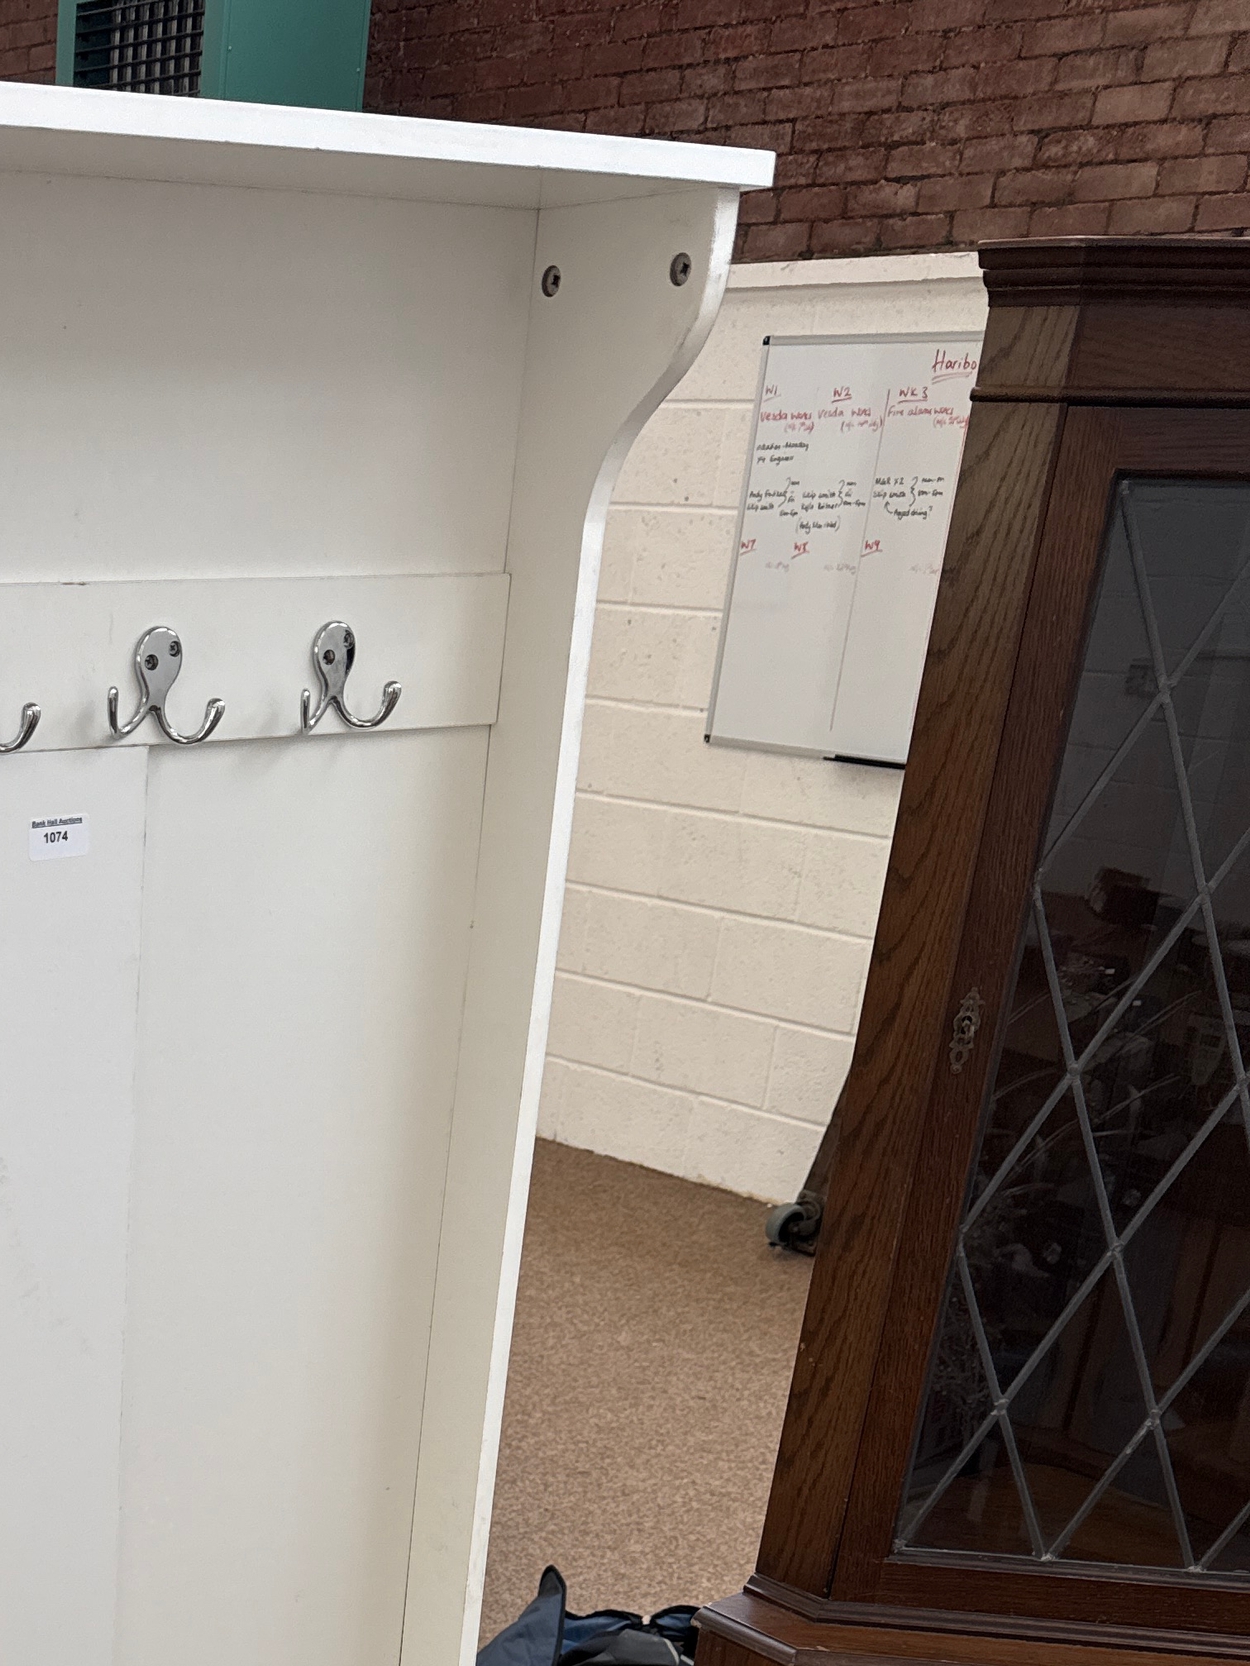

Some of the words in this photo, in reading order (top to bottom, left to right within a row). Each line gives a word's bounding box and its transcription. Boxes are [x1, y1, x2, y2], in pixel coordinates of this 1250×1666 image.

[932, 349, 977, 372] Haribo
[833, 386, 852, 398] W2
[741, 539, 756, 550] W7
[43, 830, 69, 844] 1074
